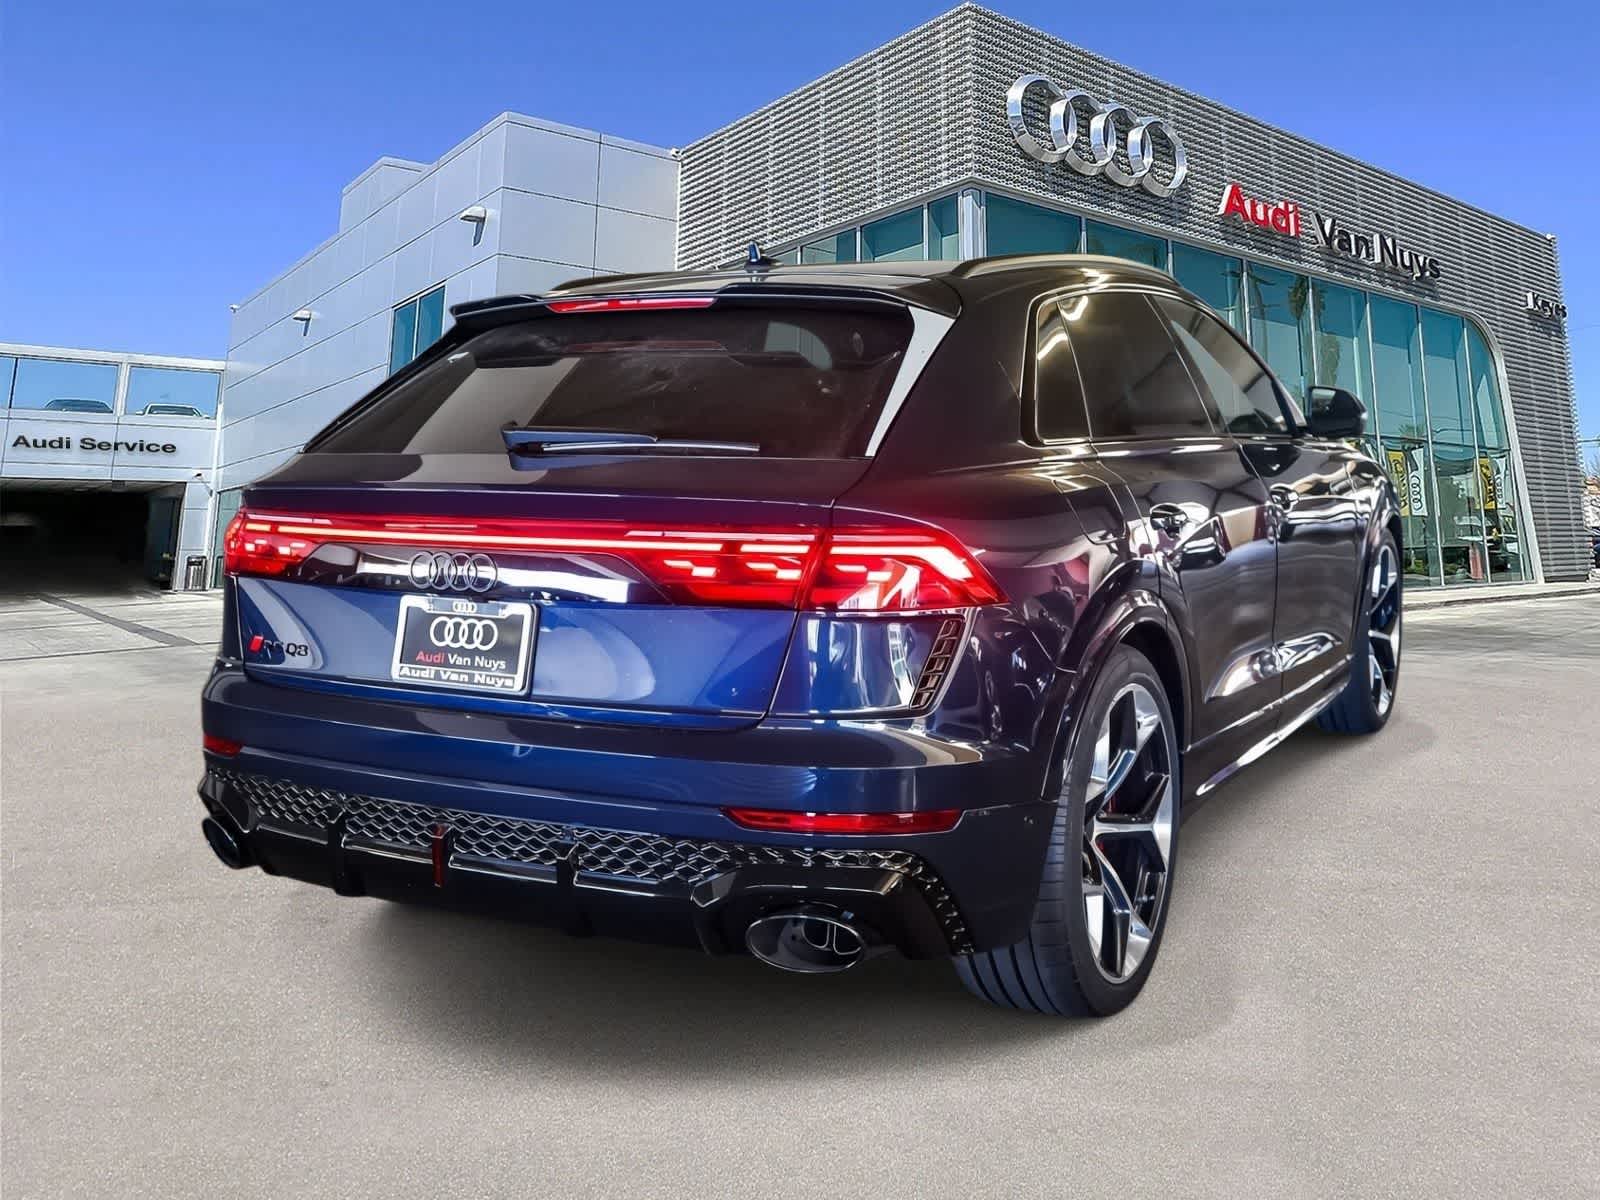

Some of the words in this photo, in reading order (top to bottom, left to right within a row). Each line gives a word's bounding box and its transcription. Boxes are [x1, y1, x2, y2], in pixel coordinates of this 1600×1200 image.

[1218, 183, 1301, 236] Audi
[1311, 212, 1371, 258] Van
[1373, 232, 1441, 280] Nuys
[12, 434, 71, 449] Audi
[79, 437, 177, 454] Service
[415, 651, 445, 664] Audi
[447, 653, 472, 667] Van
[474, 656, 506, 671] Nuys
[400, 667, 435, 679] Audi
[440, 671, 469, 683] Van
[473, 675, 514, 687] Nuys
